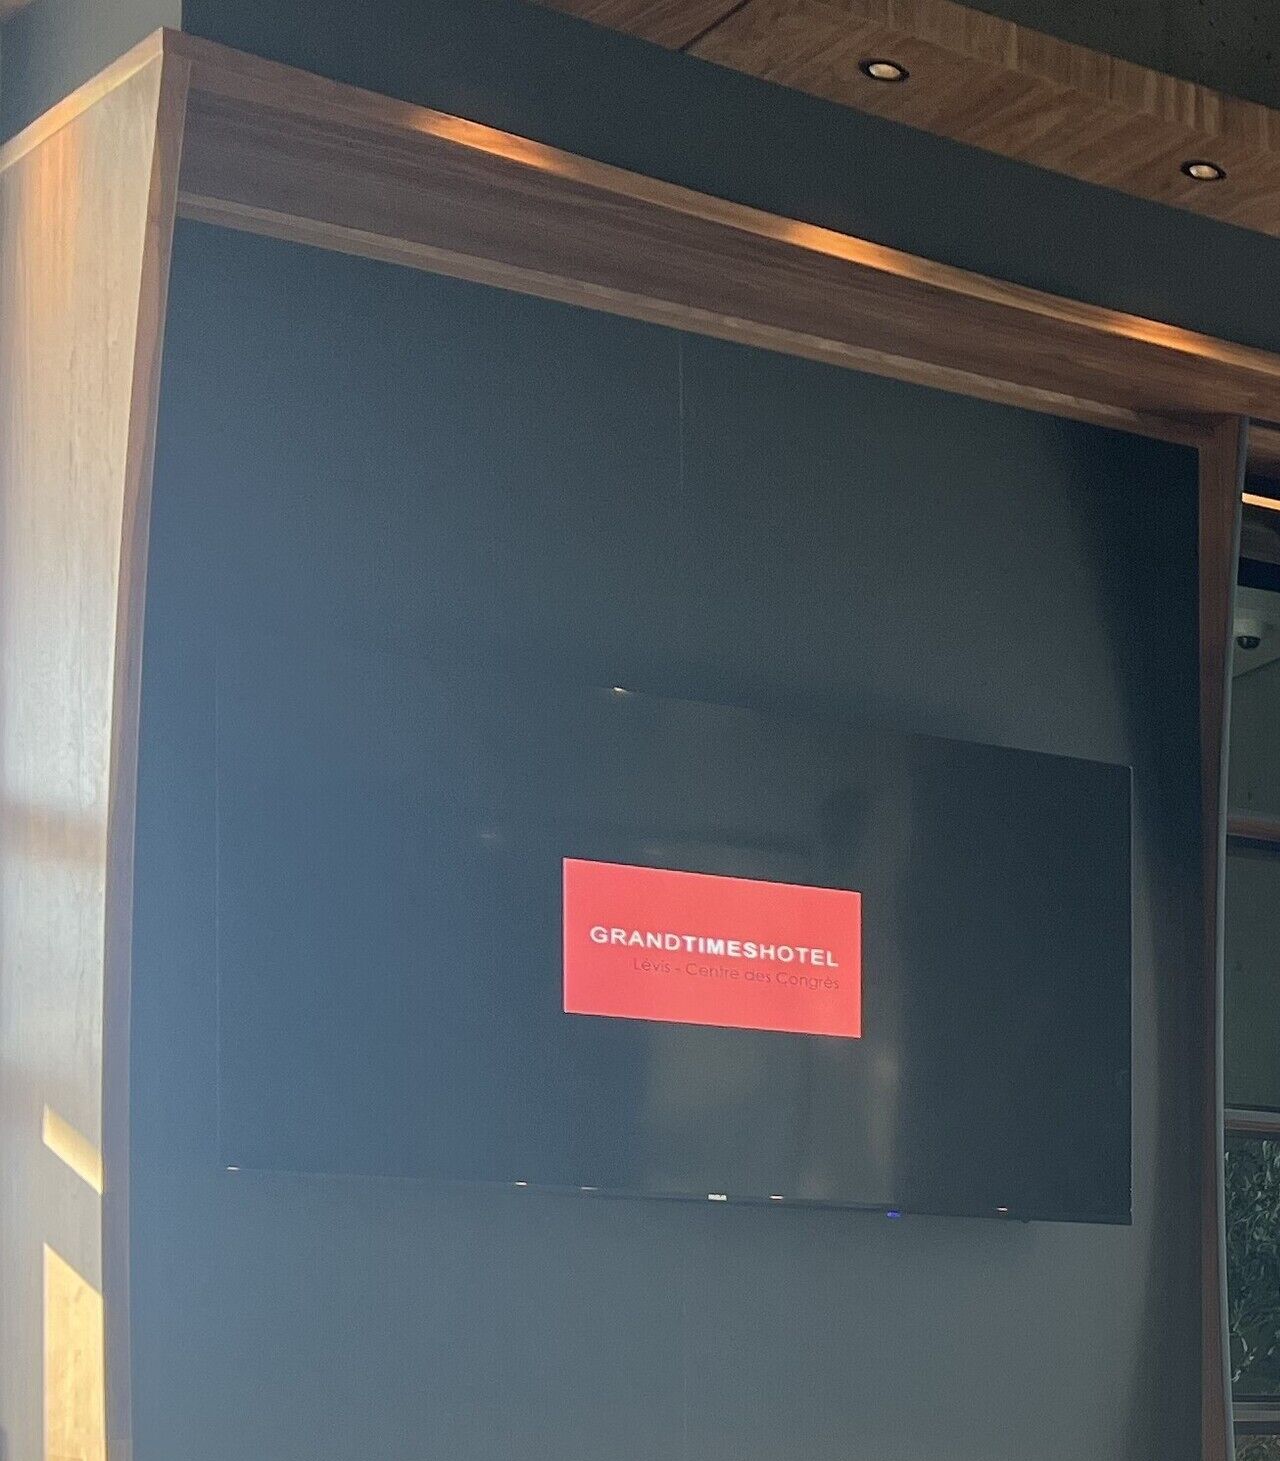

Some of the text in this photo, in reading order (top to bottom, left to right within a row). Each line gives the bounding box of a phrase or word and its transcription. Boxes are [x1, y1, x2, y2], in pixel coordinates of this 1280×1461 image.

[589, 925, 839, 967] GRANDTIMESHOTEL
[633, 957, 672, 973] Lévis
[685, 962, 740, 980] Centre
[744, 969, 771, 983] des
[776, 971, 840, 991] Congrès
